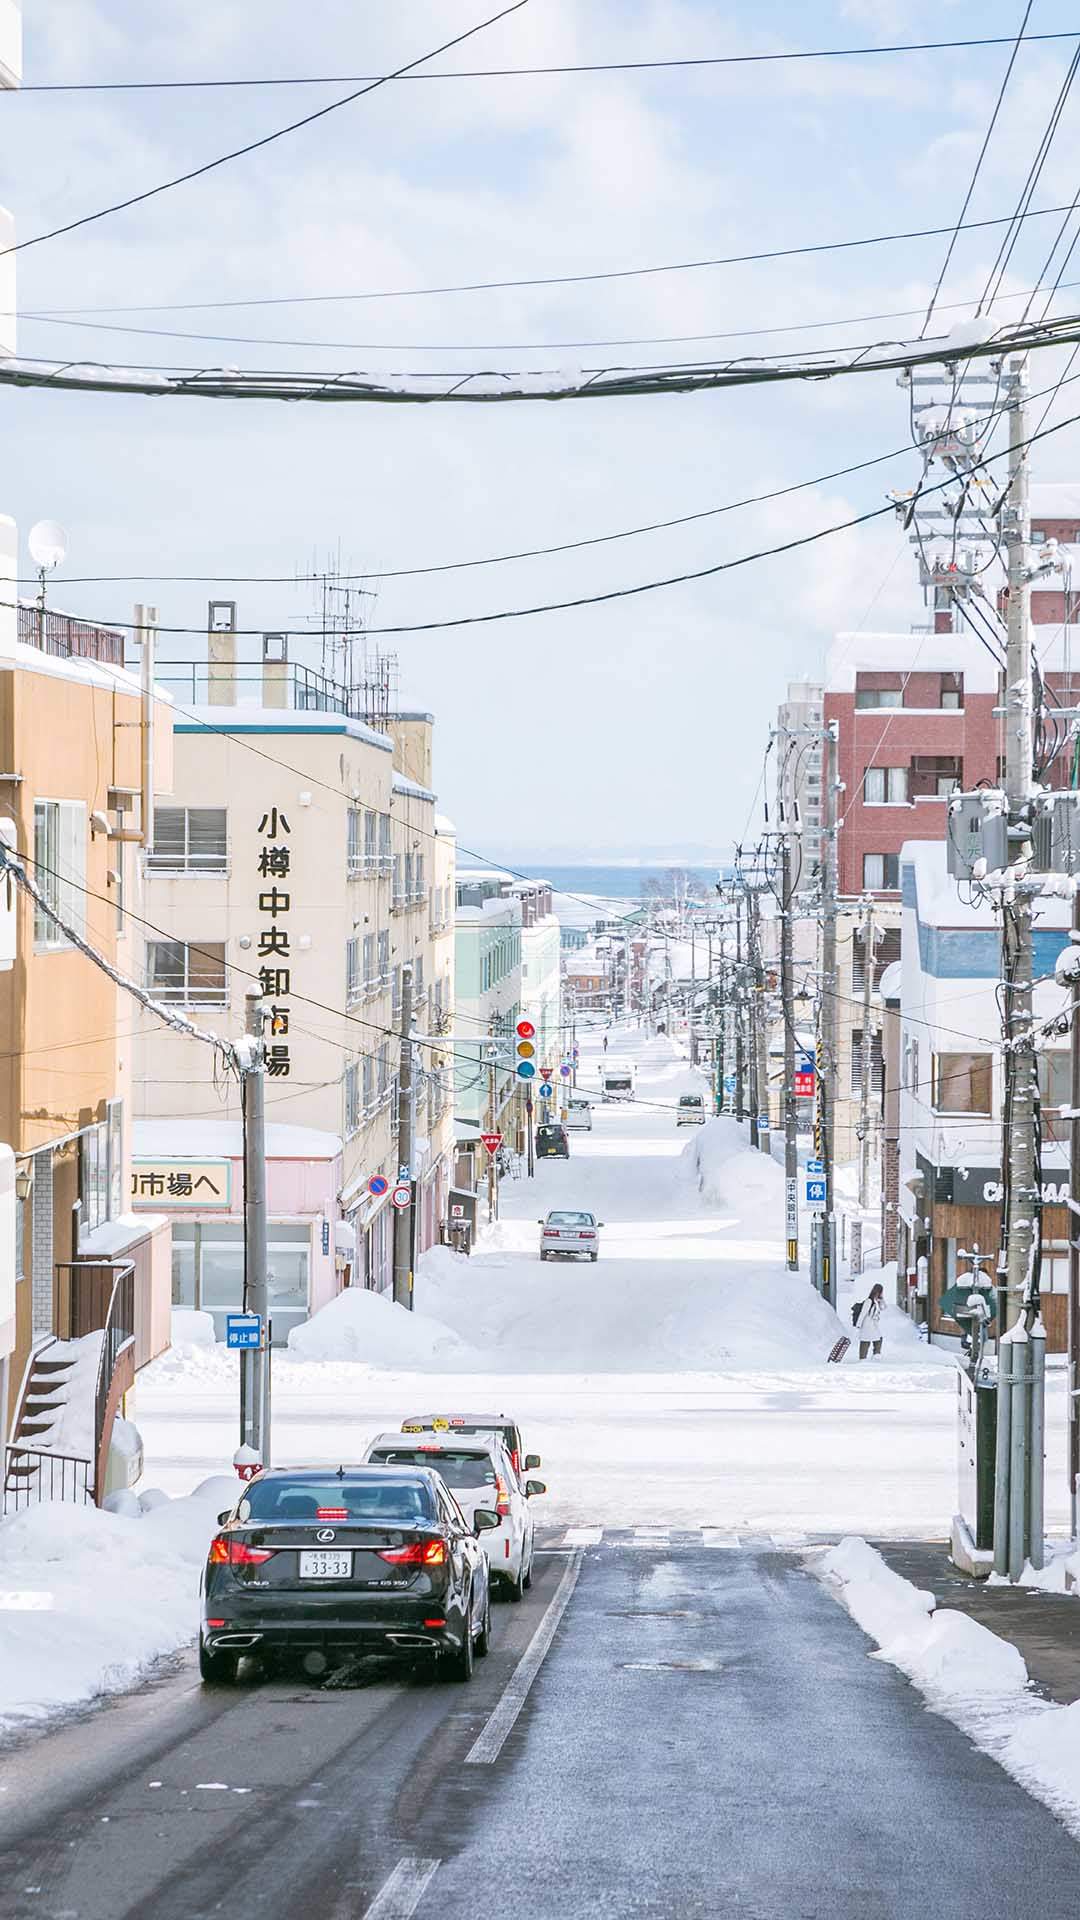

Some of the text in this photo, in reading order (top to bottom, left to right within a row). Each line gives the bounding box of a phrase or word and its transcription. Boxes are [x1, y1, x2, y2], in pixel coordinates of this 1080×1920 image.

[131, 1172, 220, 1197] 市場へ
[312, 1561, 348, 1575] 33-33
